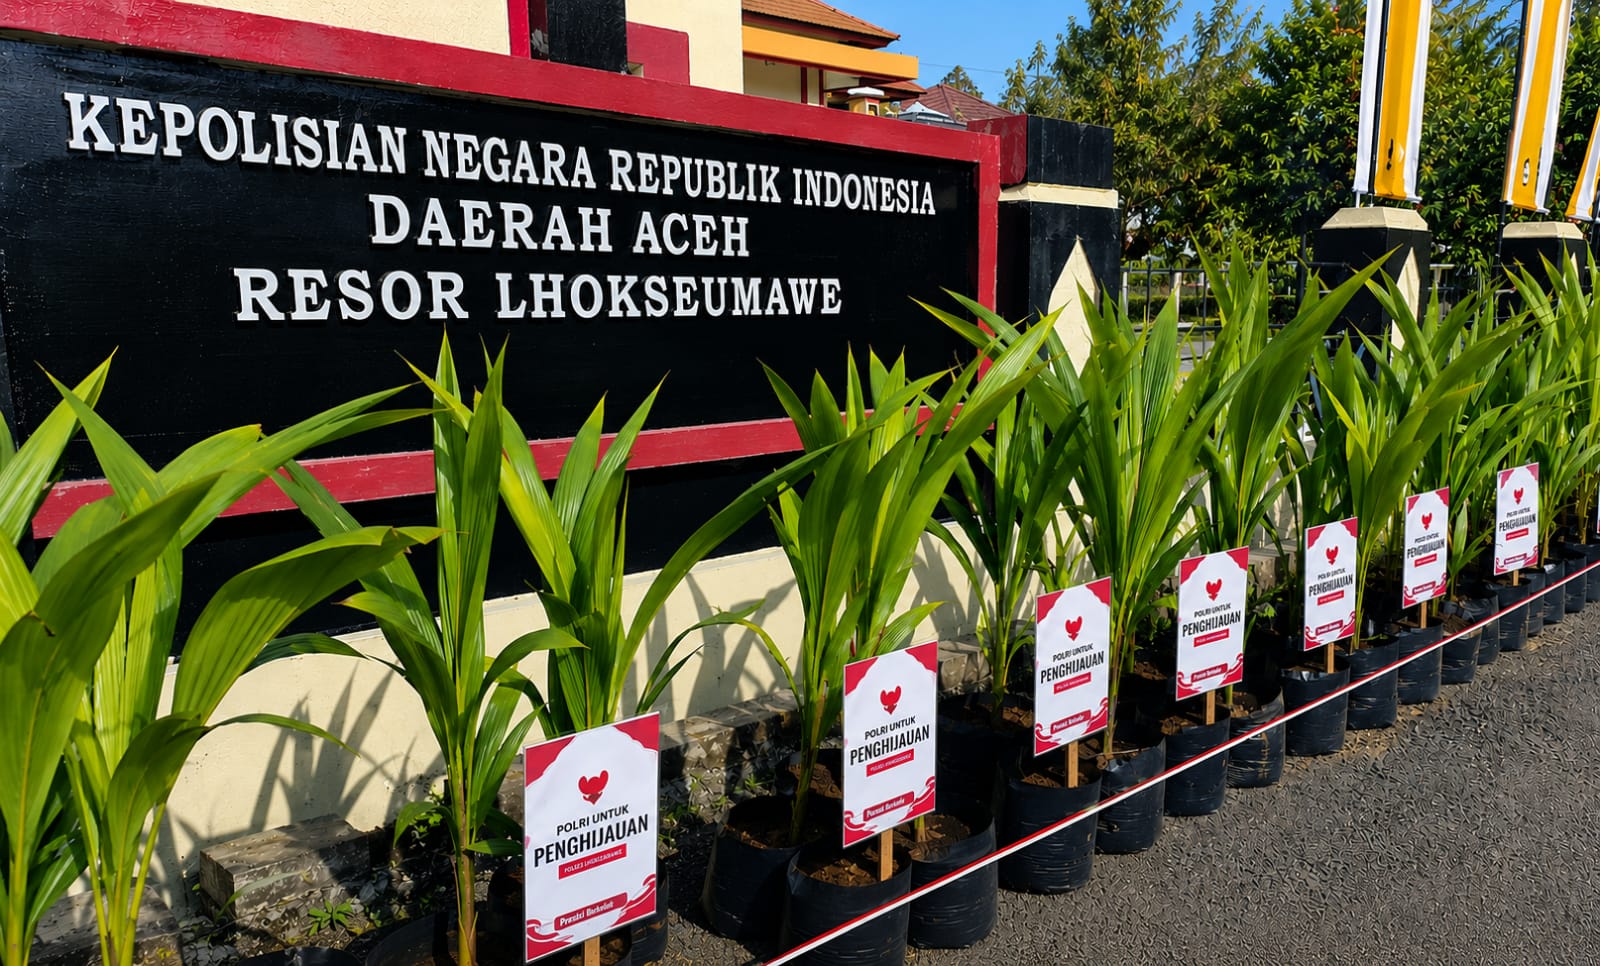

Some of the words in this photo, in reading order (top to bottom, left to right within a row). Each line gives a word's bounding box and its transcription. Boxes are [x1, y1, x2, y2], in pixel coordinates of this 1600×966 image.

[64, 92, 407, 174] KEPOLISIAN
[422, 129, 597, 190] NEGARA
[609, 149, 782, 204] REPUBLIK
[793, 168, 936, 215] INDONESIA
[369, 194, 612, 253] DAERAH
[633, 211, 749, 257] ACEH
[233, 267, 469, 321] RESOR
[495, 272, 842, 319] LHOKSEUMAWE
[1182, 610, 1241, 637] PENGHIJAUAN
[1040, 650, 1104, 684] PENGHIJAUAN
[1052, 649, 1072, 662] POLRI
[1073, 643, 1093, 656] UNTUK
[850, 724, 930, 766] PENGHIJAUAN
[864, 725, 888, 740] POLRI
[889, 715, 916, 731] UNTUK
[556, 817, 590, 836] POLRI
[592, 804, 629, 824] UNTUK
[534, 814, 648, 868] PENGHIJAUAN
